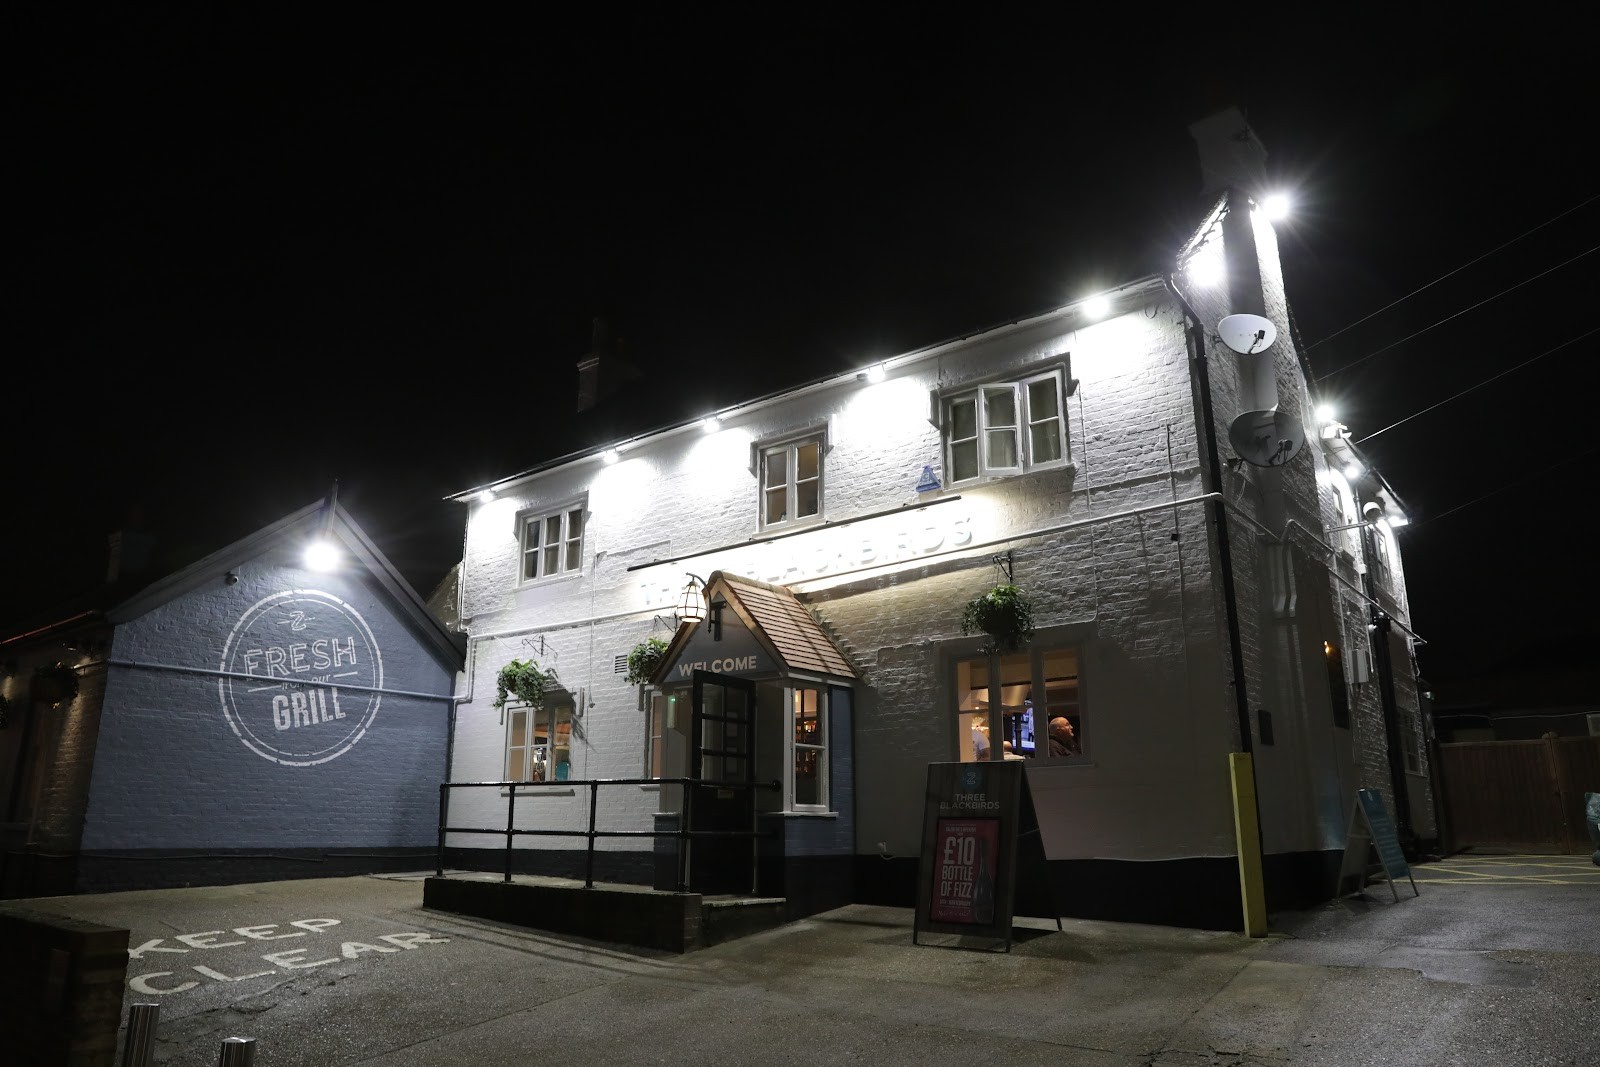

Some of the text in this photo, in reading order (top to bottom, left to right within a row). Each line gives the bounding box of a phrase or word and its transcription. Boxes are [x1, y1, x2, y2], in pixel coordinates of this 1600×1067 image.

[244, 636, 357, 681] FRESH
[678, 655, 757, 677] WELCOME
[272, 686, 346, 731] GRILL
[940, 801, 1000, 810] BLACKBIRDS
[955, 793, 986, 802] THREE
[943, 836, 976, 866] £10
[942, 865, 974, 882] BOTTLE
[940, 881, 972, 899] OF FIZZ
[127, 918, 342, 959] KEEP
[128, 932, 451, 995] CLEAR
